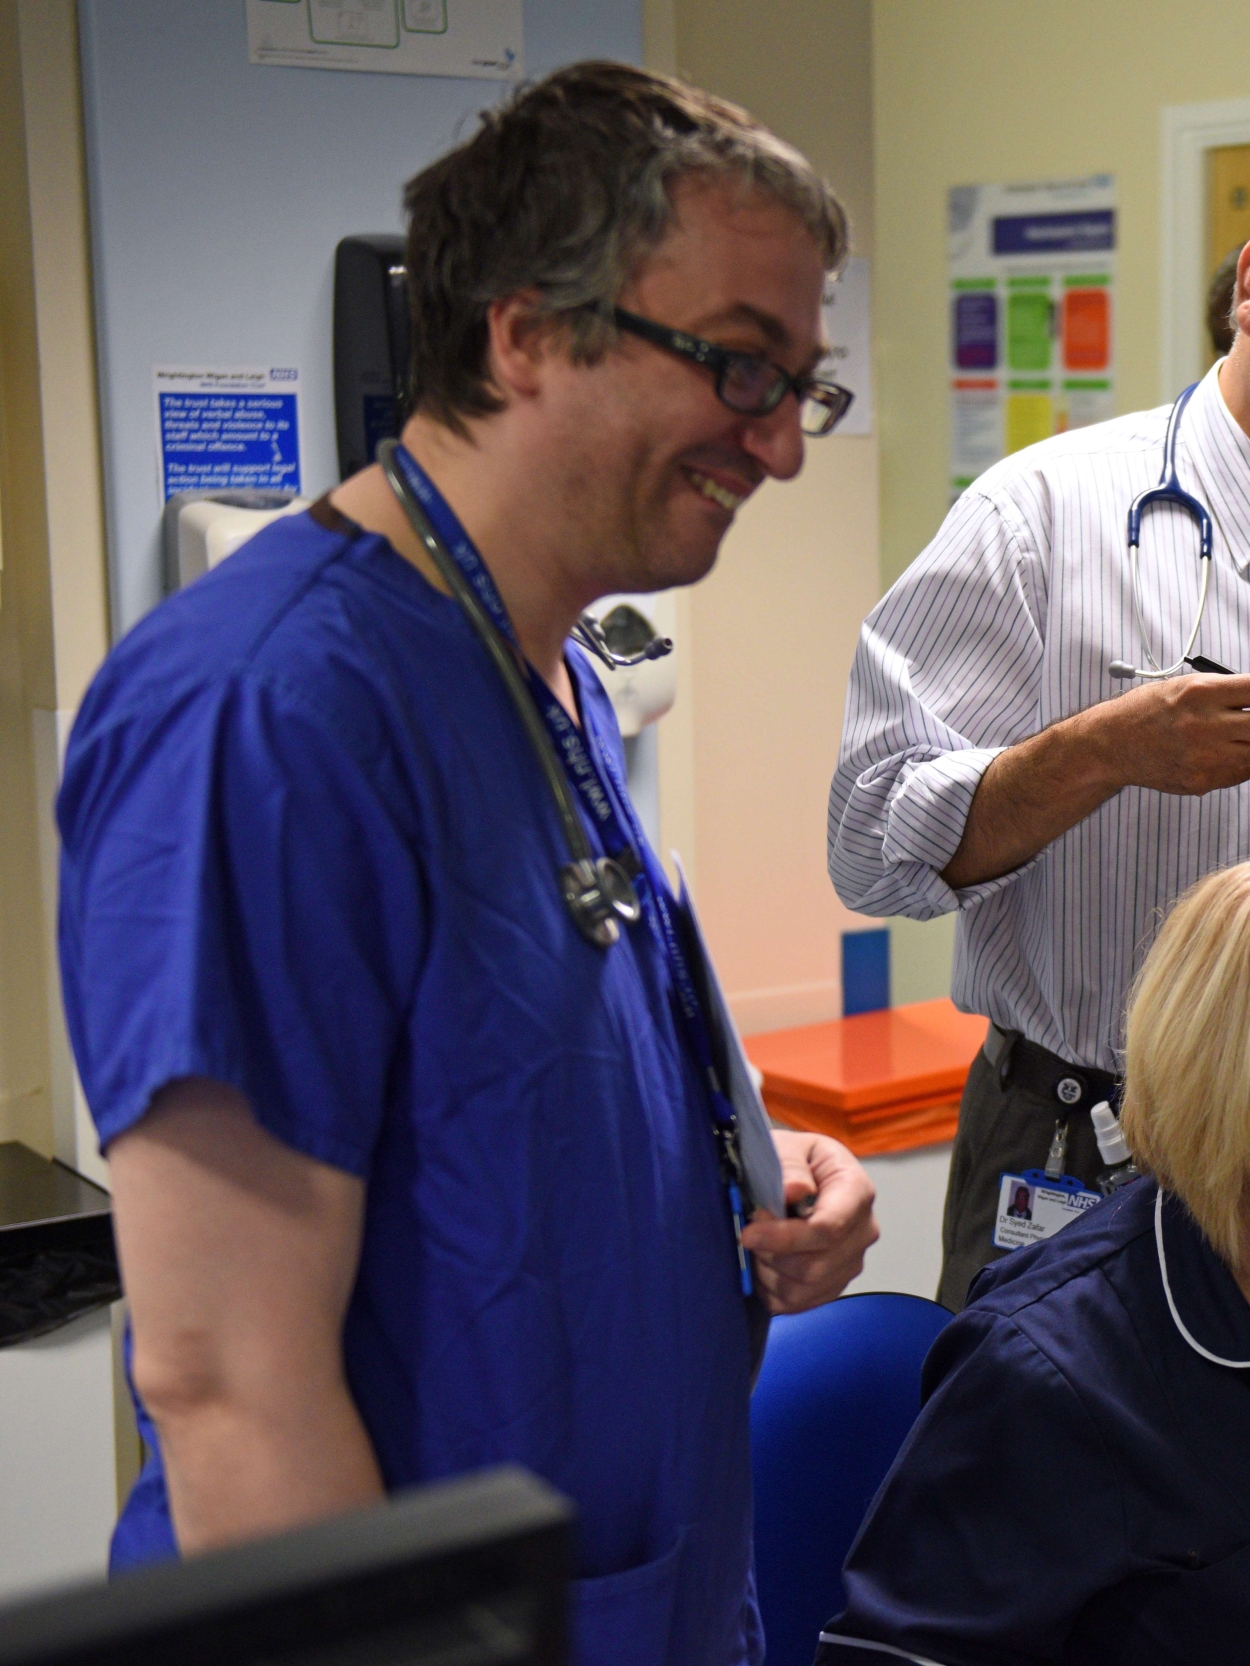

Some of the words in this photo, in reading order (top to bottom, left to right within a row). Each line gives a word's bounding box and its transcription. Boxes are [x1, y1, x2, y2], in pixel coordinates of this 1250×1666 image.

[164, 397, 183, 408] The
[184, 398, 209, 408] trust
[210, 398, 237, 408] takes
[247, 399, 283, 408] serious
[201, 409, 233, 420] verbal
[164, 420, 199, 430] threats
[201, 420, 220, 430] and
[222, 420, 263, 430] violence
[165, 430, 188, 440] staff
[189, 431, 219, 440] which
[221, 431, 259, 441] amount
[165, 441, 206, 452] criminal
[168, 463, 187, 473] The
[188, 464, 212, 473] trust
[213, 463, 231, 473] will
[232, 464, 271, 474] support
[167, 475, 199, 485] action
[200, 475, 228, 487] being
[230, 475, 257, 484] taken
[546, 704, 612, 822] wwl.nhs.uk
[1068, 1195, 1095, 1209] NHS
[1000, 1215, 1007, 1223] Dr
[1009, 1218, 1026, 1228] Syed
[1027, 1223, 1045, 1232] Zafar
[1000, 1227, 1029, 1239] Consultant
